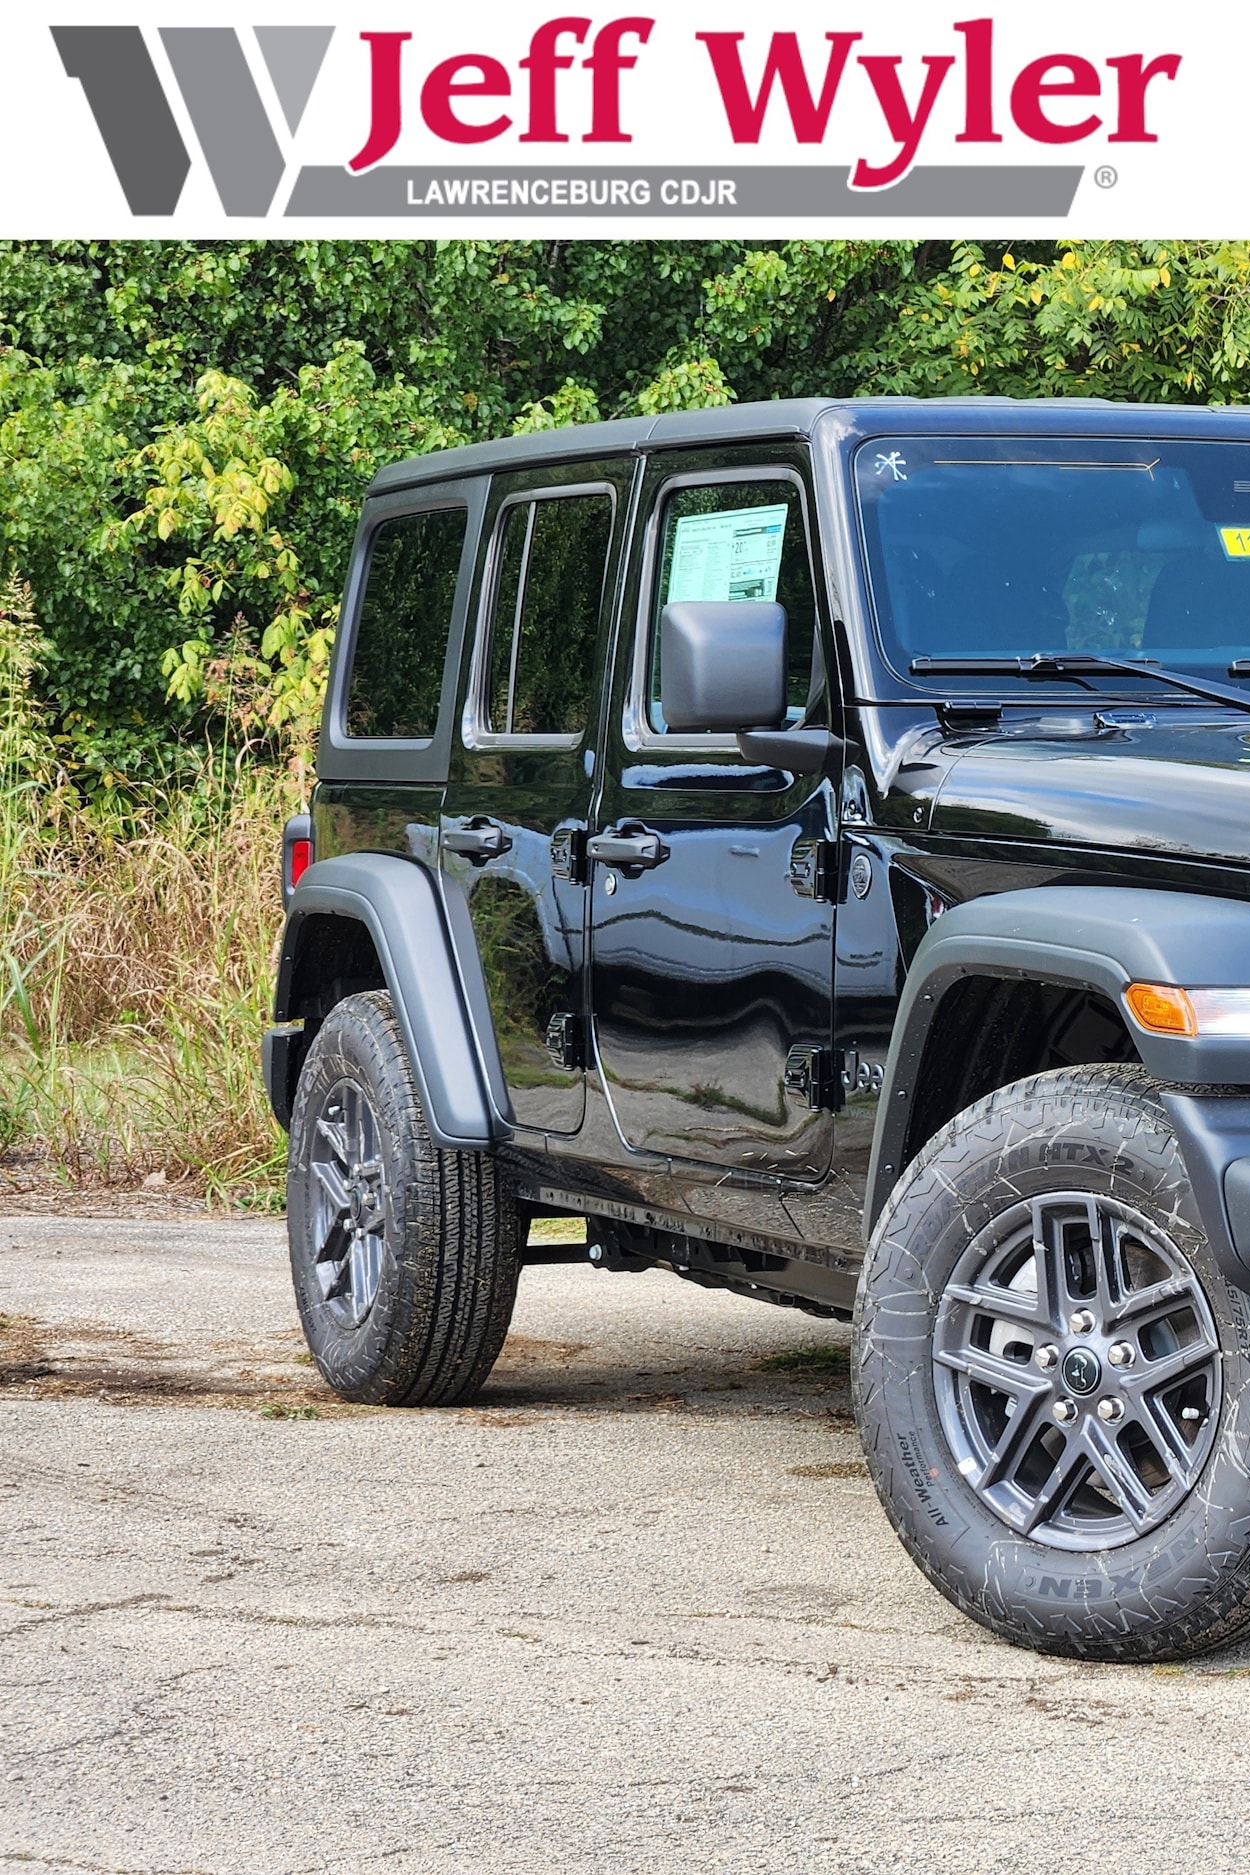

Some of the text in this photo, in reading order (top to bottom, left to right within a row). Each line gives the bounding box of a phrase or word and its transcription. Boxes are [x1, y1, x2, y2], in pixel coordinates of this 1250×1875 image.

[841, 1050, 884, 1096] Jee
[897, 1432, 949, 1526] All-Weather
[909, 1430, 936, 1488] Performance
[1038, 1526, 1201, 1600] NEXEN
